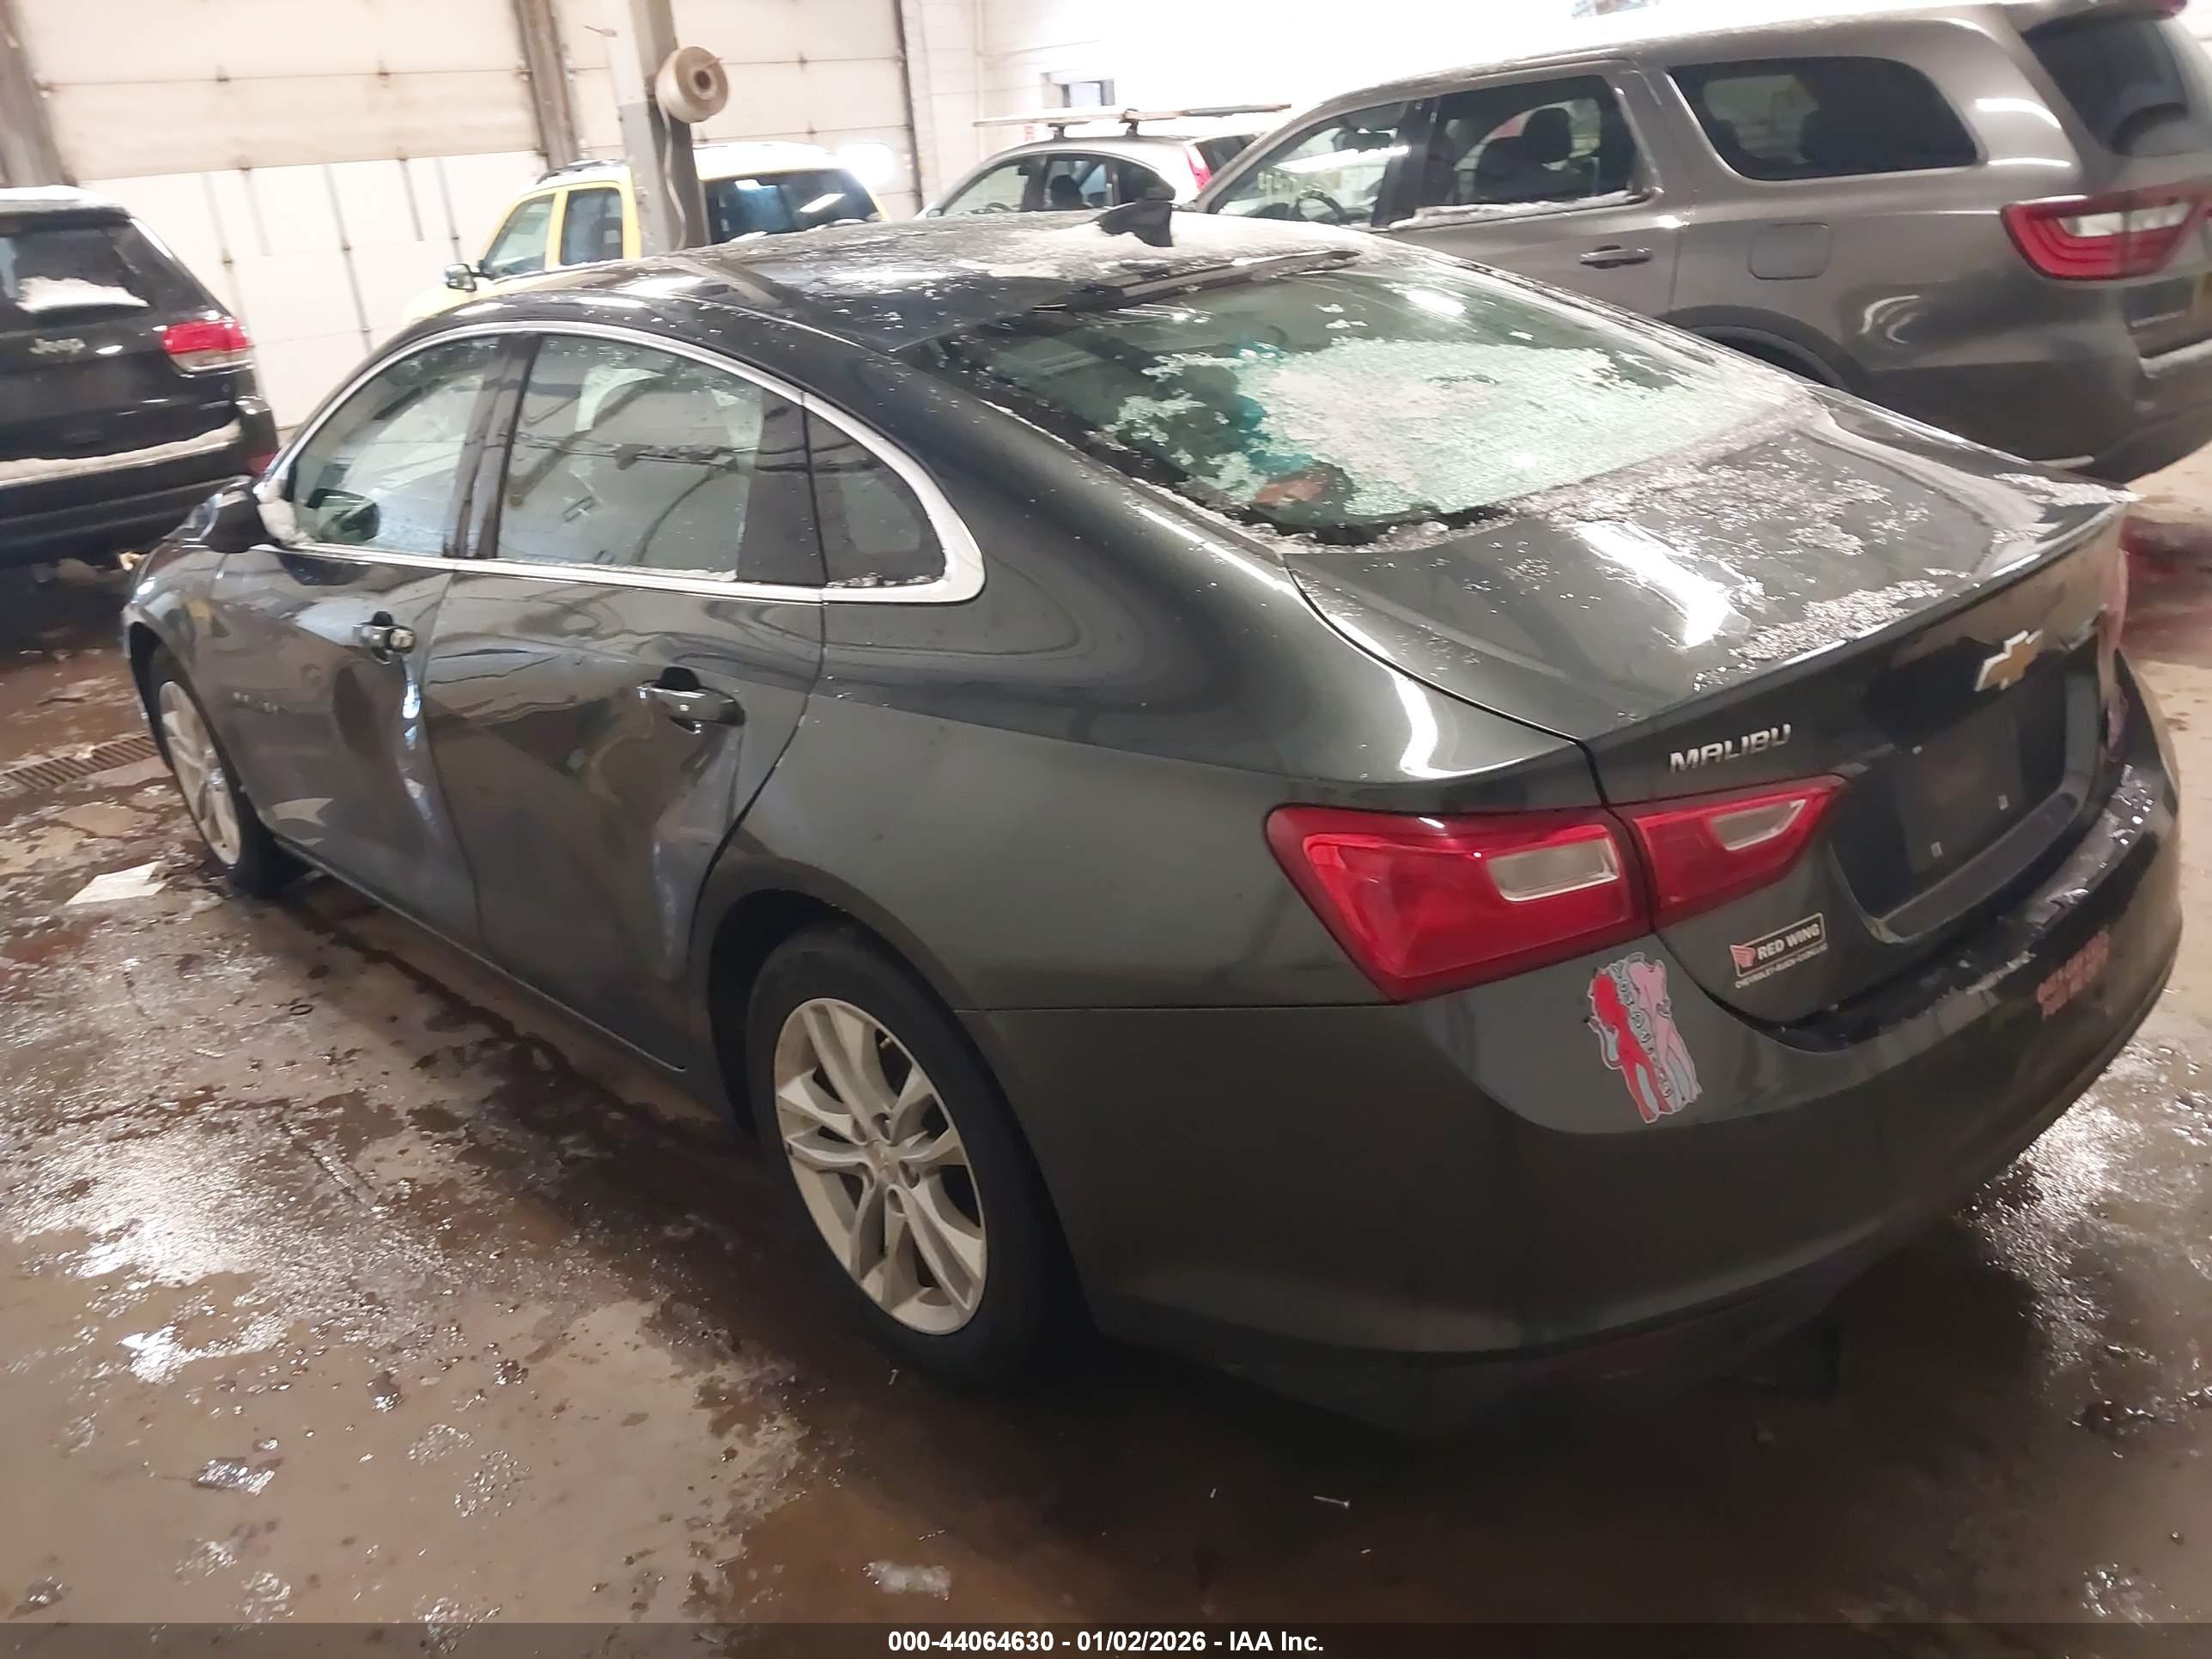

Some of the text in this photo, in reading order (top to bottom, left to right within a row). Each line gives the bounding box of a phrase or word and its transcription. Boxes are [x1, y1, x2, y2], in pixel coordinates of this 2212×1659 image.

[1668, 723, 1792, 773] MALIBU
[1757, 922, 1820, 960] RED WING
